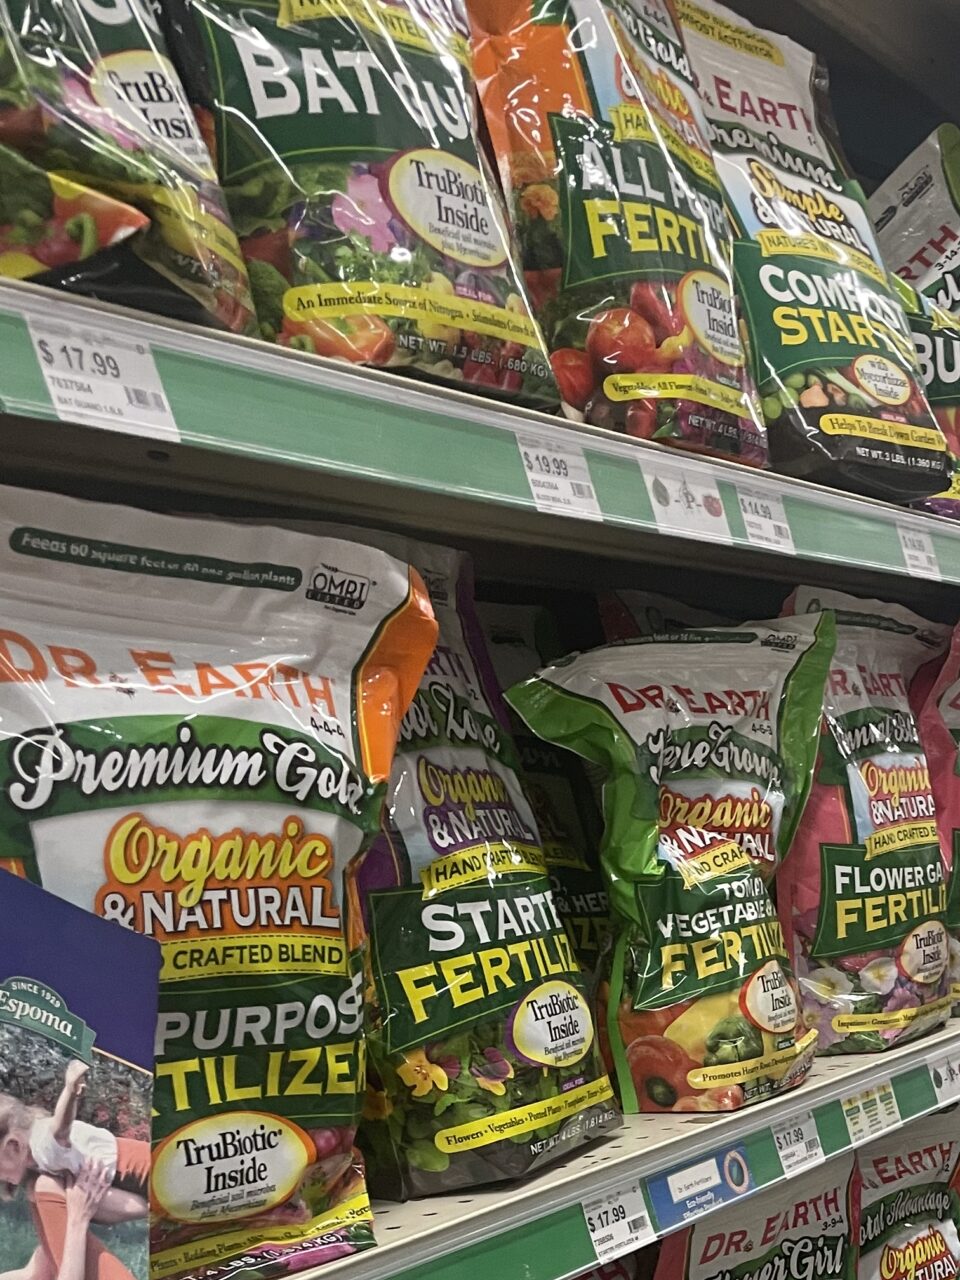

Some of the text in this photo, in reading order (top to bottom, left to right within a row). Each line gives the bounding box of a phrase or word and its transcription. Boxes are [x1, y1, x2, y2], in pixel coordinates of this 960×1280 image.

[232, 35, 381, 120] BAT
[580, 138, 666, 202] ALL
[749, 158, 845, 224] Simple
[436, 196, 490, 237] Inside
[296, 293, 383, 311] An Immediate
[38, 339, 121, 379] $ 17.99
[399, 335, 424, 352] NET
[857, 419, 869, 431] To
[525, 453, 569, 479] $ 19.99
[856, 446, 870, 459] NET
[891, 453, 908, 465] LBS.
[747, 505, 773, 522] 14.99
[69, 541, 89, 557] 60
[311, 571, 367, 604] OMRI
[128, 646, 342, 721] EARTH
[8, 722, 268, 811] Premium
[658, 784, 772, 831] Organic
[448, 807, 536, 843] NATURAL
[107, 812, 331, 909] Organic
[834, 863, 925, 896] FLOWER
[142, 884, 343, 936] NATURAL
[173, 940, 345, 979] CRAFTED BLEND
[11, 979, 41, 994] SINCE
[0, 986, 74, 1036] Espoma
[547, 1017, 580, 1043] Inside
[702, 1068, 743, 1085] Promotes
[177, 1128, 281, 1168] TruBiotic
[445, 1129, 485, 1146] Flowers
[782, 1126, 805, 1148] 17.99
[203, 1159, 269, 1197] Inside
[597, 1204, 627, 1230] 17.99
